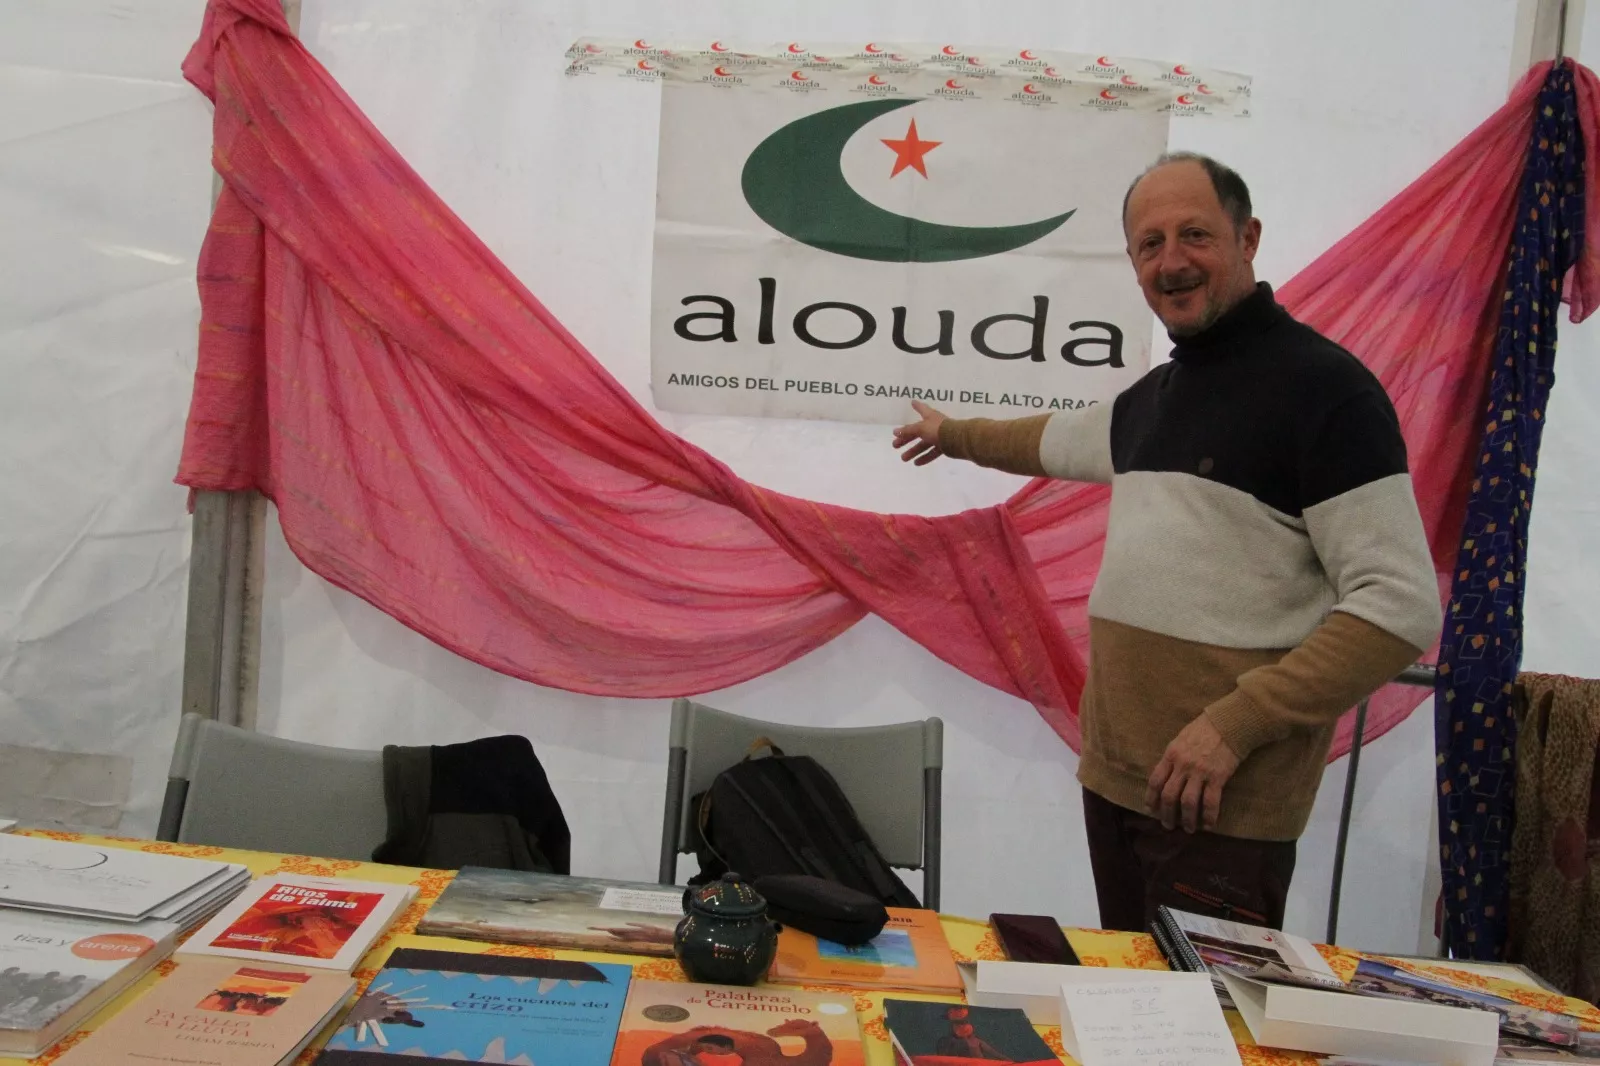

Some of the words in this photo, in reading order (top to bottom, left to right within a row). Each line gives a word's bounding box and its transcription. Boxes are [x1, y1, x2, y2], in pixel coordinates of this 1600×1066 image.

[1008, 58, 1048, 67] alouda
[626, 68, 666, 77] alouda
[955, 65, 996, 74] alouda
[1084, 64, 1125, 74] alouda
[702, 75, 743, 83] alouda
[1032, 74, 1072, 84] alouda
[1161, 73, 1202, 84] alouda
[779, 80, 820, 88] alouda
[857, 84, 897, 92] alouda
[1109, 83, 1149, 92] alouda
[934, 87, 974, 96] alouda
[1012, 92, 1052, 101] alouda
[1088, 97, 1129, 107] alouda
[1165, 103, 1205, 112] alouda
[673, 277, 1126, 368] alouda
[667, 373, 740, 389] AMIGOS
[745, 377, 779, 391] DEL
[784, 379, 859, 396] PUEBLO
[864, 384, 954, 402] SAHARAUI
[959, 390, 995, 405] DEL
[999, 393, 1044, 409] ALTO
[276, 885, 328, 899] Ritos
[268, 893, 296, 904] de
[297, 895, 358, 909] jaima
[14, 933, 52, 945] tiza
[58, 939, 73, 948] y
[79, 940, 142, 954] arena
[468, 992, 501, 1001] Los
[507, 996, 577, 1007] cuentos
[582, 1000, 610, 1009] del
[704, 989, 791, 1004] Palabras
[686, 996, 702, 1004] de
[707, 999, 812, 1015] Caramelo
[153, 1008, 176, 1020] YA
[144, 1017, 170, 1028] LA
[177, 1020, 250, 1037] LLUVIA
